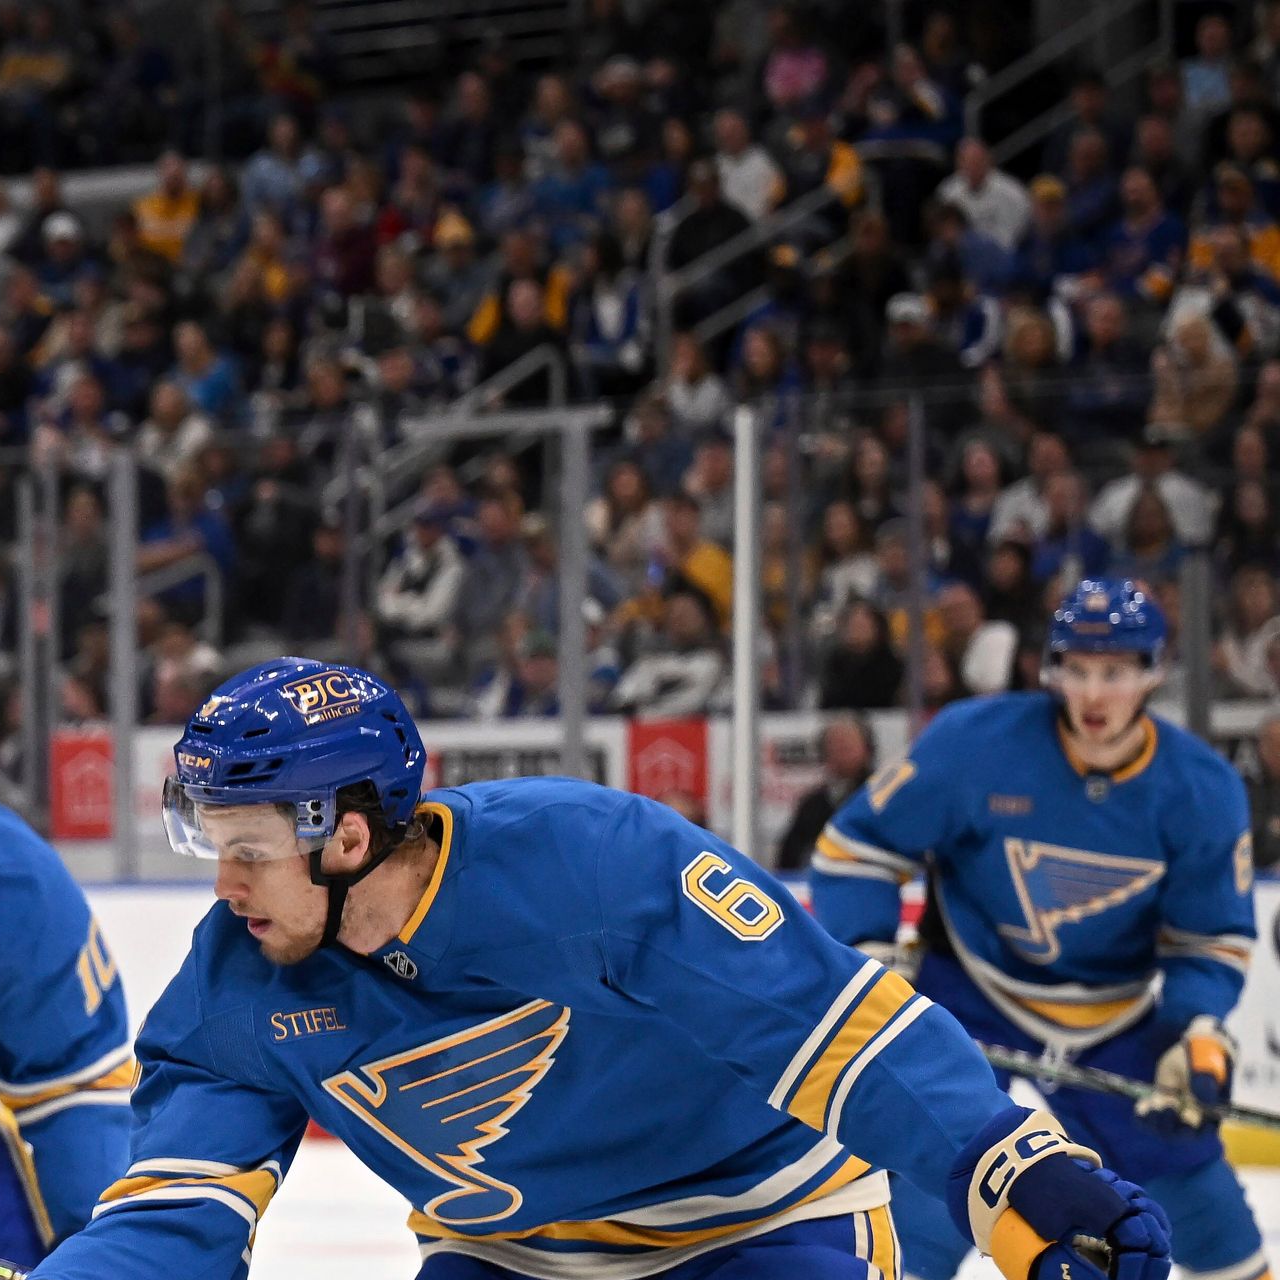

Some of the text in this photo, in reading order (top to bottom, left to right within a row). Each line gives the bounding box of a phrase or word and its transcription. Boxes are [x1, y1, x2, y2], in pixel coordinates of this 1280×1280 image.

[294, 676, 349, 707] BJC
[178, 752, 211, 769] CCM
[681, 851, 785, 942] 6
[76, 914, 119, 1018] 10
[271, 1005, 348, 1043] STIFEL
[979, 1130, 1074, 1210] CC
